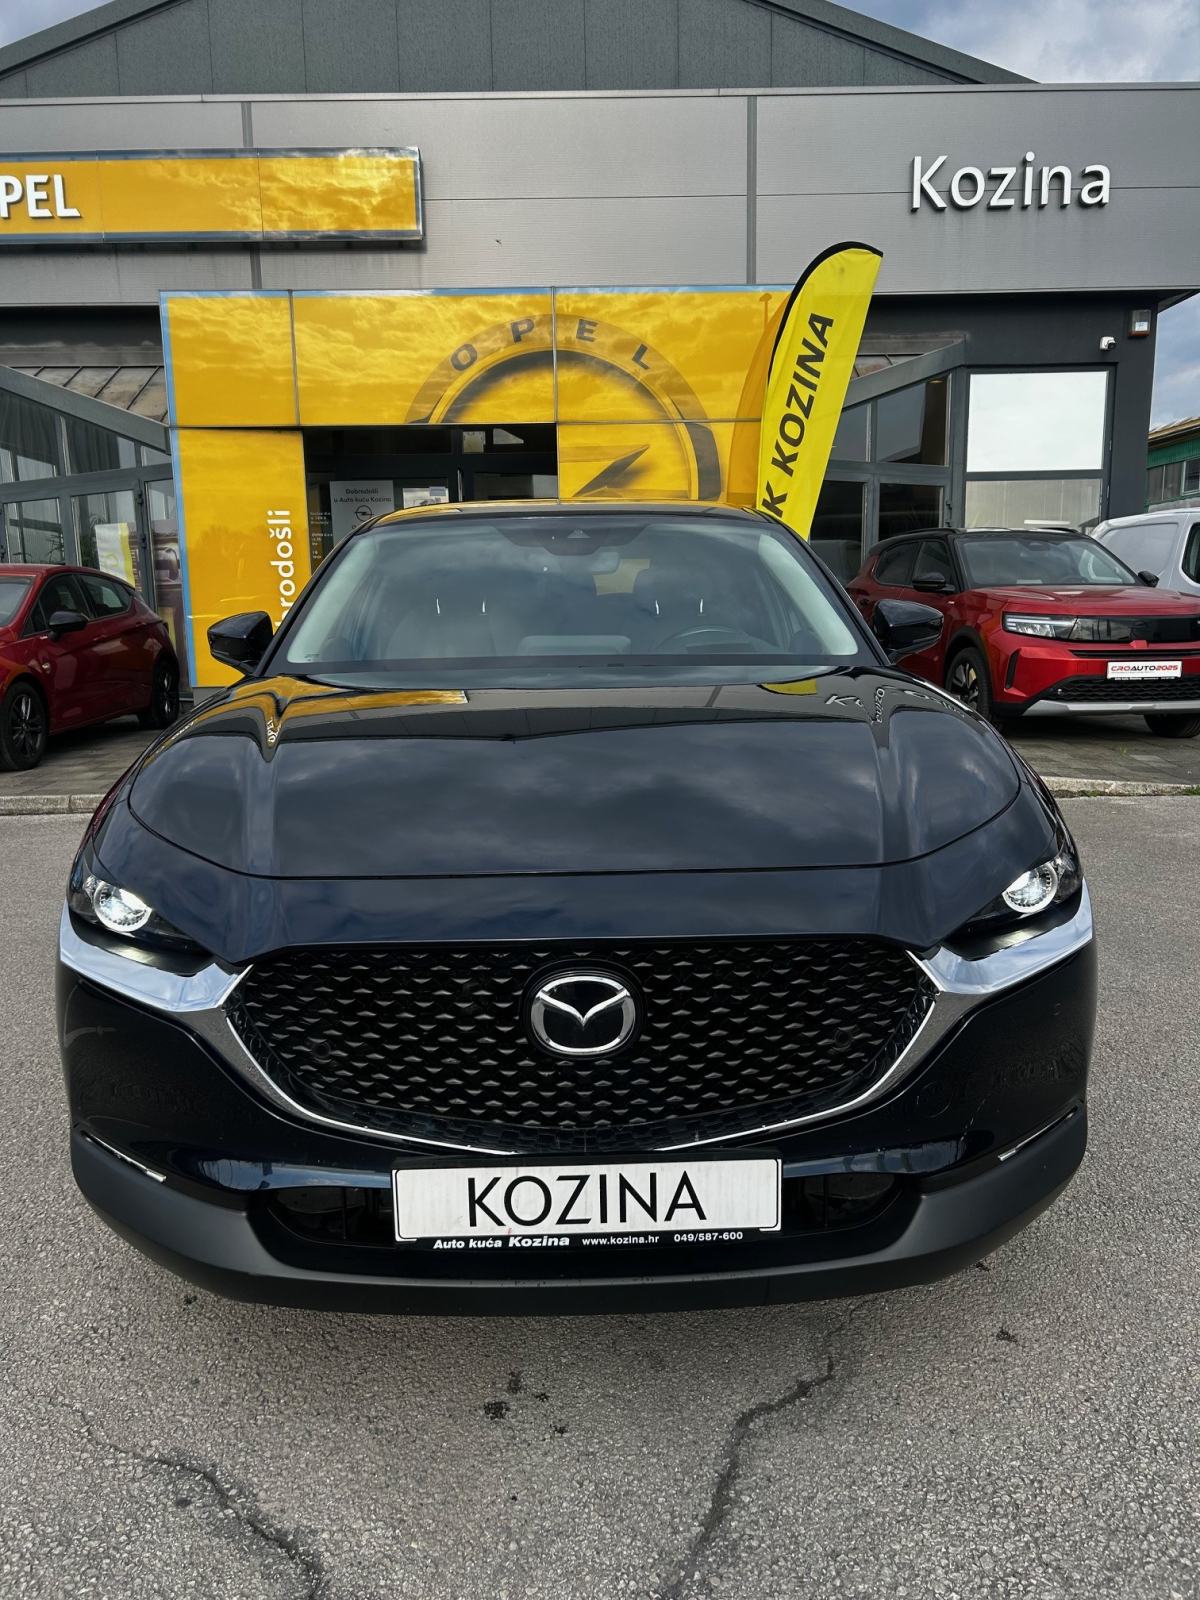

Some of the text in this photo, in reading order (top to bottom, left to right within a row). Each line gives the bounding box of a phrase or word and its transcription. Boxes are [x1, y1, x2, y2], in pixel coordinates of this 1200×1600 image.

[911, 151, 1111, 211] Kozina
[451, 318, 650, 372] OPEL
[761, 313, 834, 518] K KOZINA
[467, 1170, 708, 1227] KOZINA
[433, 1231, 744, 1249] Auto kuća Kozina www.kozina.hr 049/587-600
